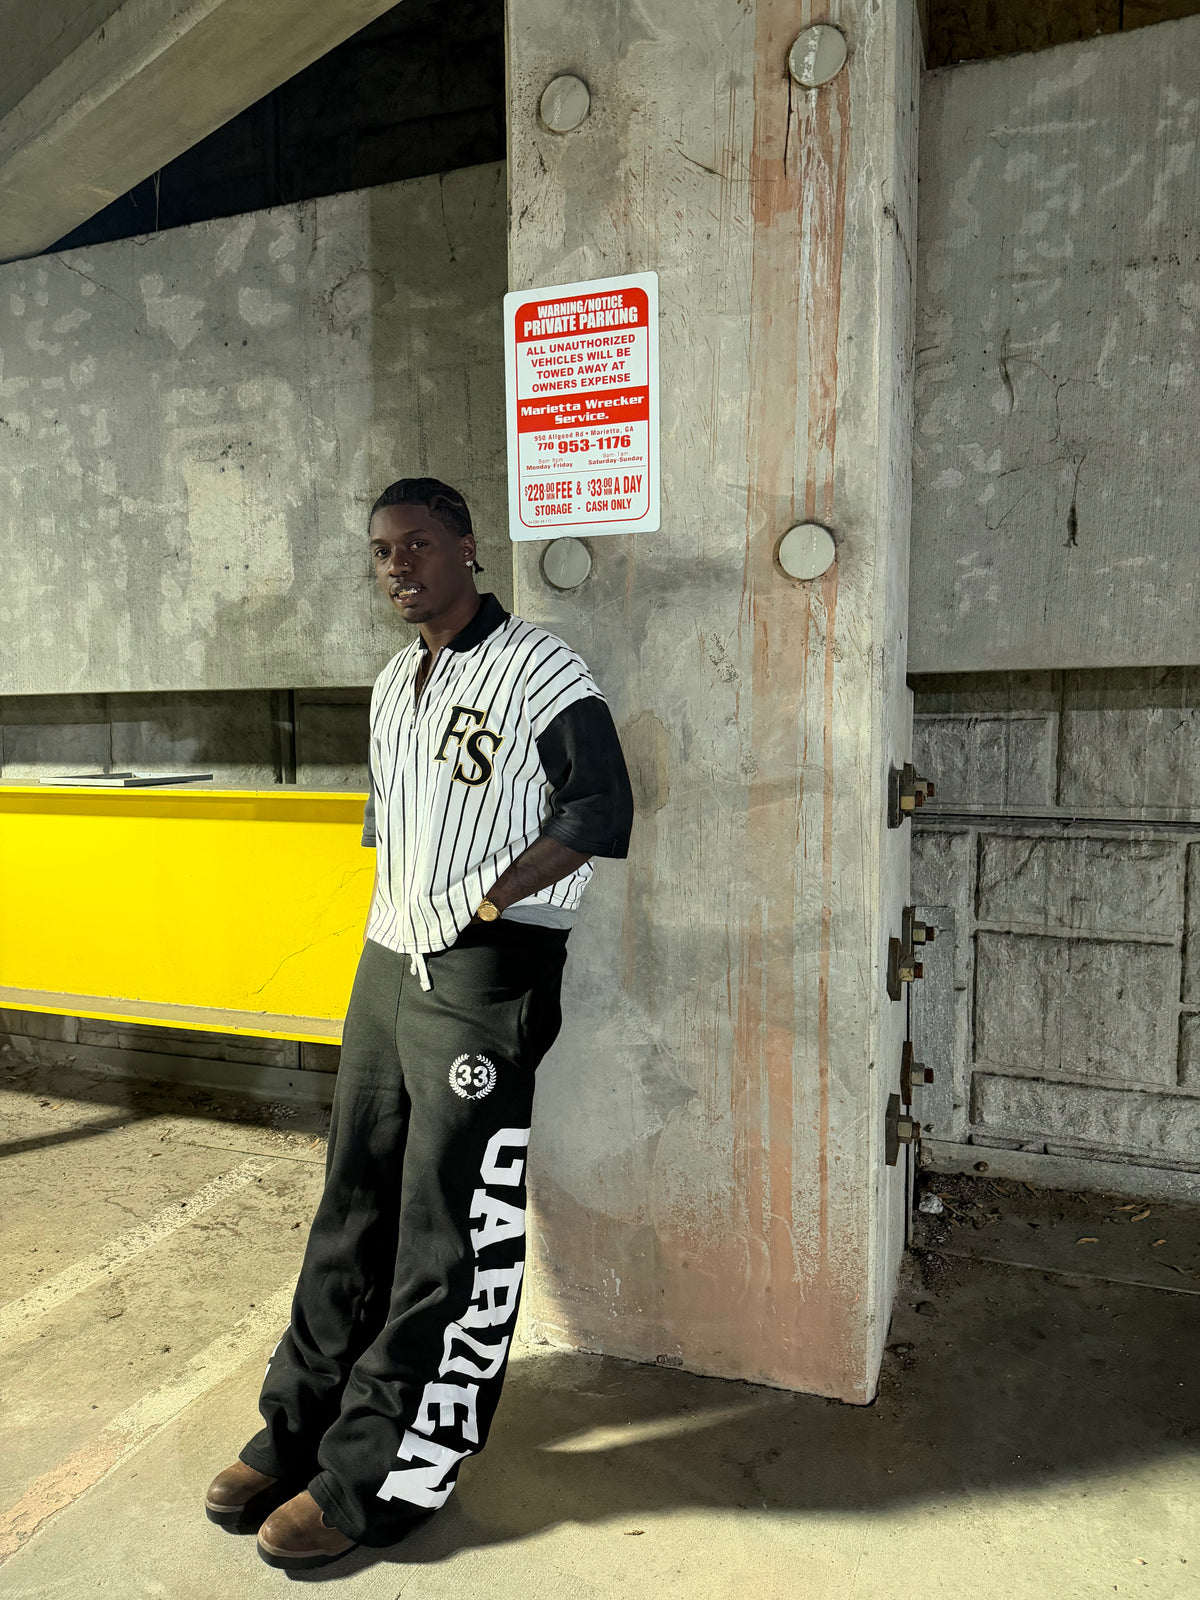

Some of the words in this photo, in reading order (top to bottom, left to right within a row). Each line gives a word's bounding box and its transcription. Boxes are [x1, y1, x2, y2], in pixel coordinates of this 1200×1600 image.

[537, 295, 623, 319] WARNING/NOTICE
[523, 314, 577, 337] PRIVATE
[579, 306, 638, 330] PARKING
[526, 345, 546, 356] ALL
[549, 334, 636, 353] UNAUTHORIZED
[531, 353, 584, 368] VEHICLES
[587, 349, 613, 361] WILL
[616, 347, 631, 358] BE
[536, 367, 574, 380] TOWED
[577, 363, 608, 375] AWAY
[611, 360, 626, 371] AT
[532, 380, 577, 393] OWNERS
[580, 373, 631, 387] EXPENSE
[520, 402, 581, 417] Marietta
[585, 395, 645, 409] Wrecker
[554, 411, 609, 425] Service.
[537, 441, 554, 451] 770
[557, 434, 631, 454] 953-1176
[548, 432, 573, 440] Allgood
[556, 481, 572, 499] FEE
[576, 480, 582, 495] &
[614, 476, 621, 495] A
[623, 474, 643, 494] DAY
[534, 503, 572, 517] STORAGE
[585, 500, 608, 512] CASH
[611, 498, 632, 510] ONLY
[433, 704, 506, 787] FS
[457, 1064, 489, 1088] 33
[376, 1127, 532, 1511] GARDEN
